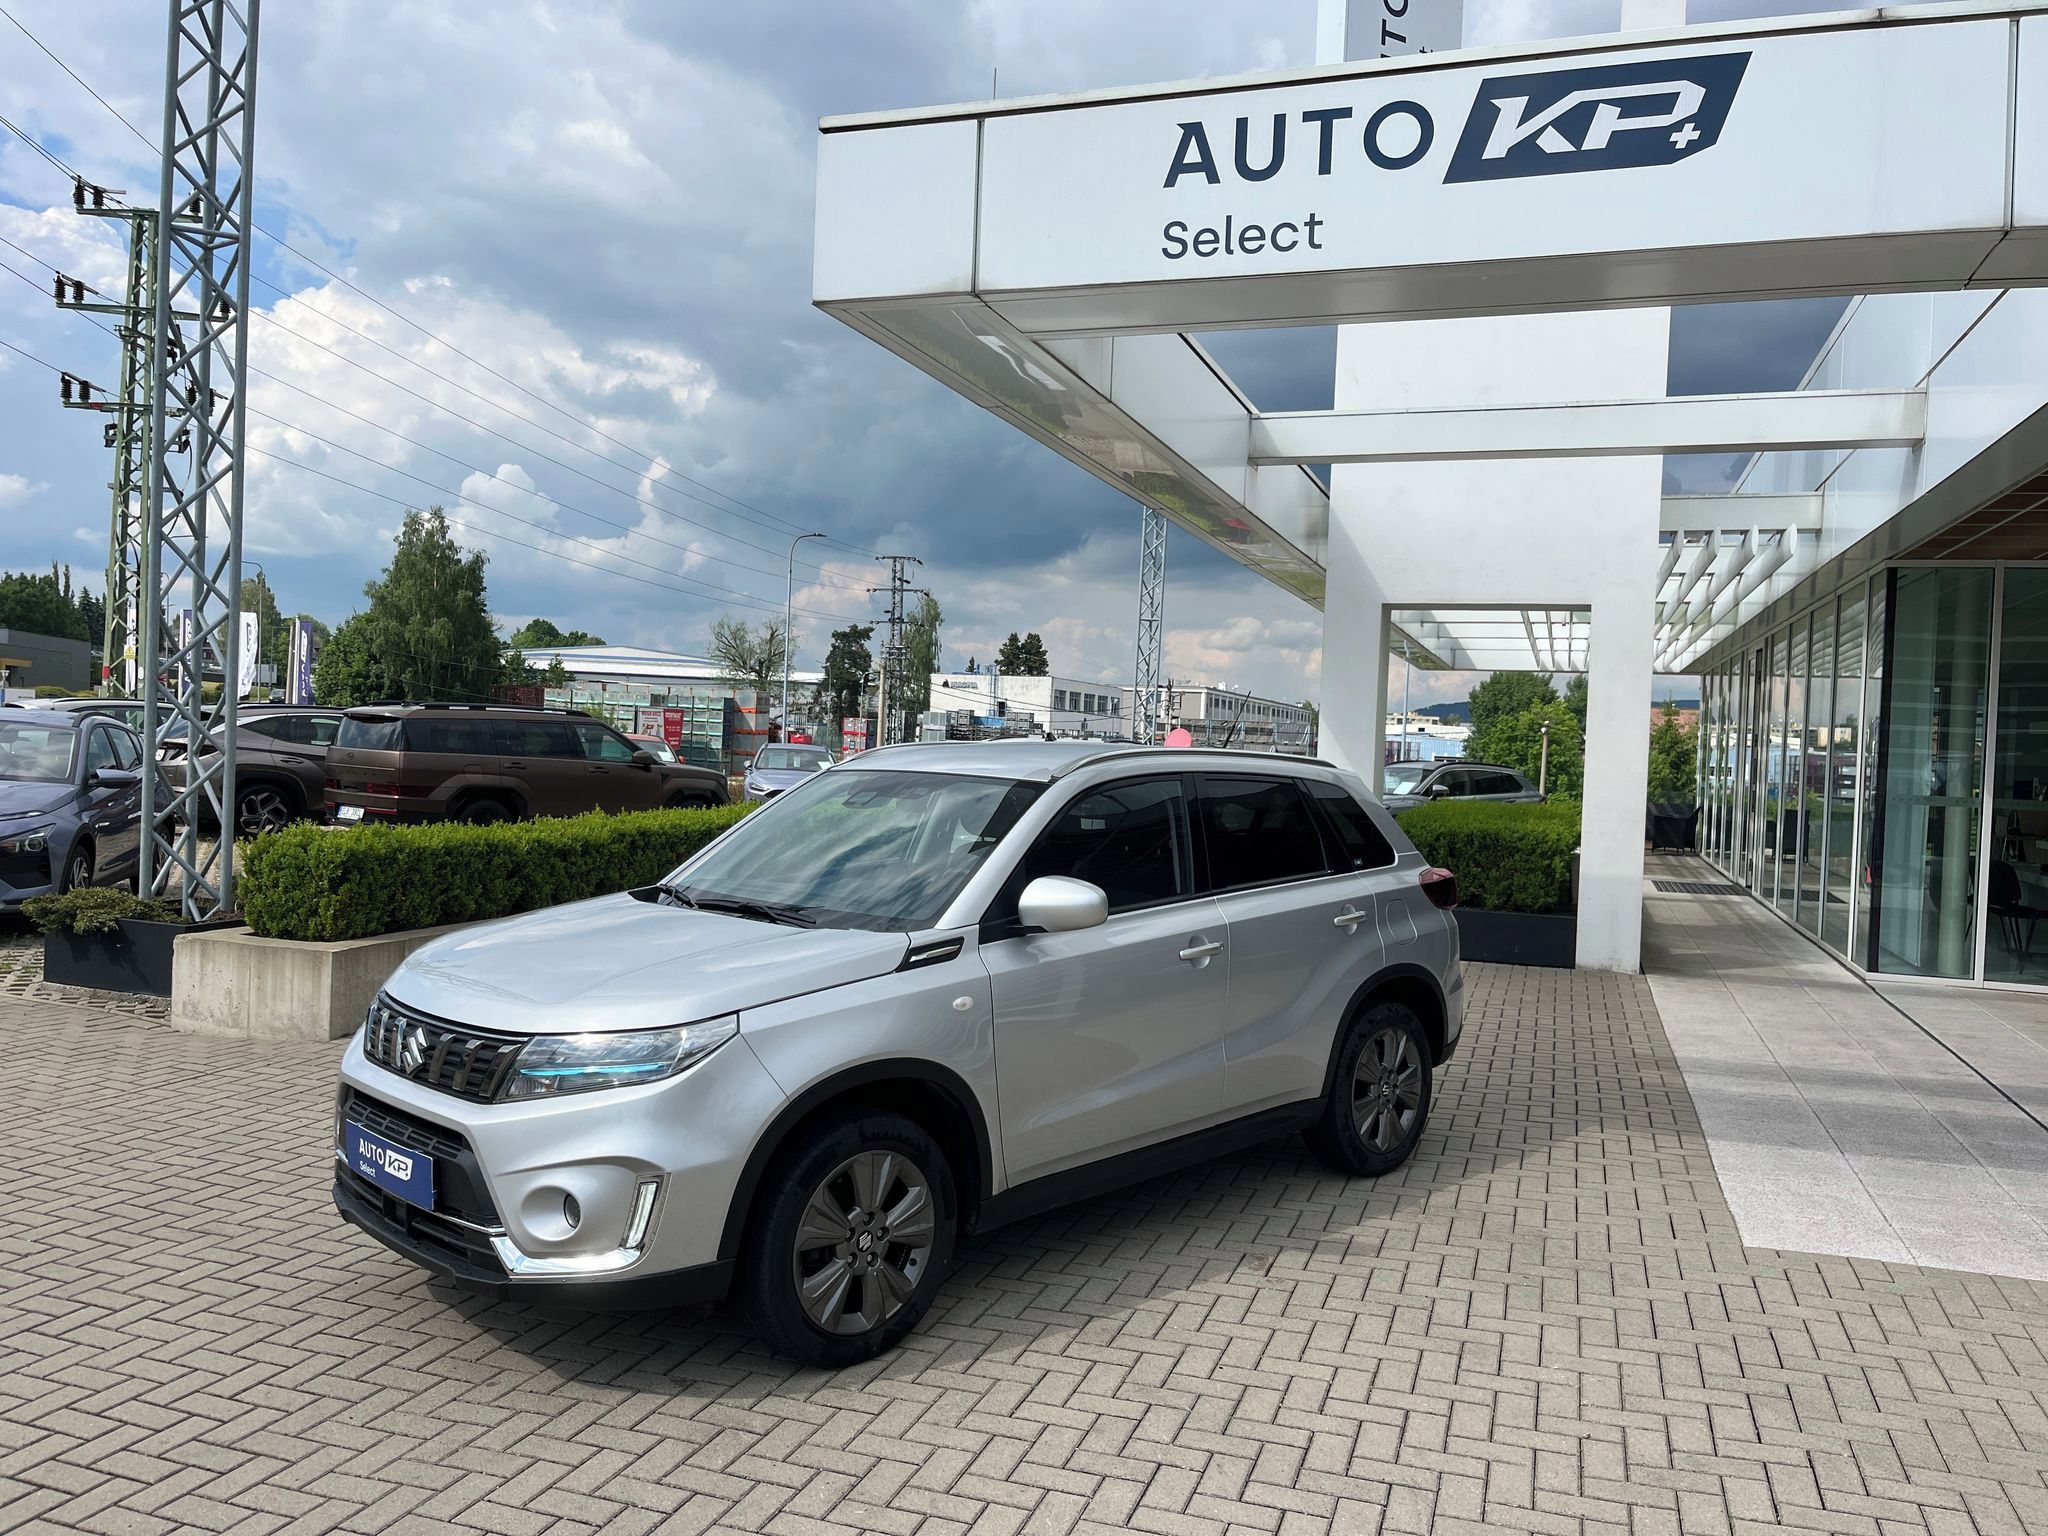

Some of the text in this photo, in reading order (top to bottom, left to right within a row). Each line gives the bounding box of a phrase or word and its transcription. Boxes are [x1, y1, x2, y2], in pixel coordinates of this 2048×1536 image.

[1162, 99, 1435, 189] AUTO
[1161, 212, 1324, 260] Select
[359, 1138, 385, 1165] AUTO
[359, 1160, 376, 1178] Select
